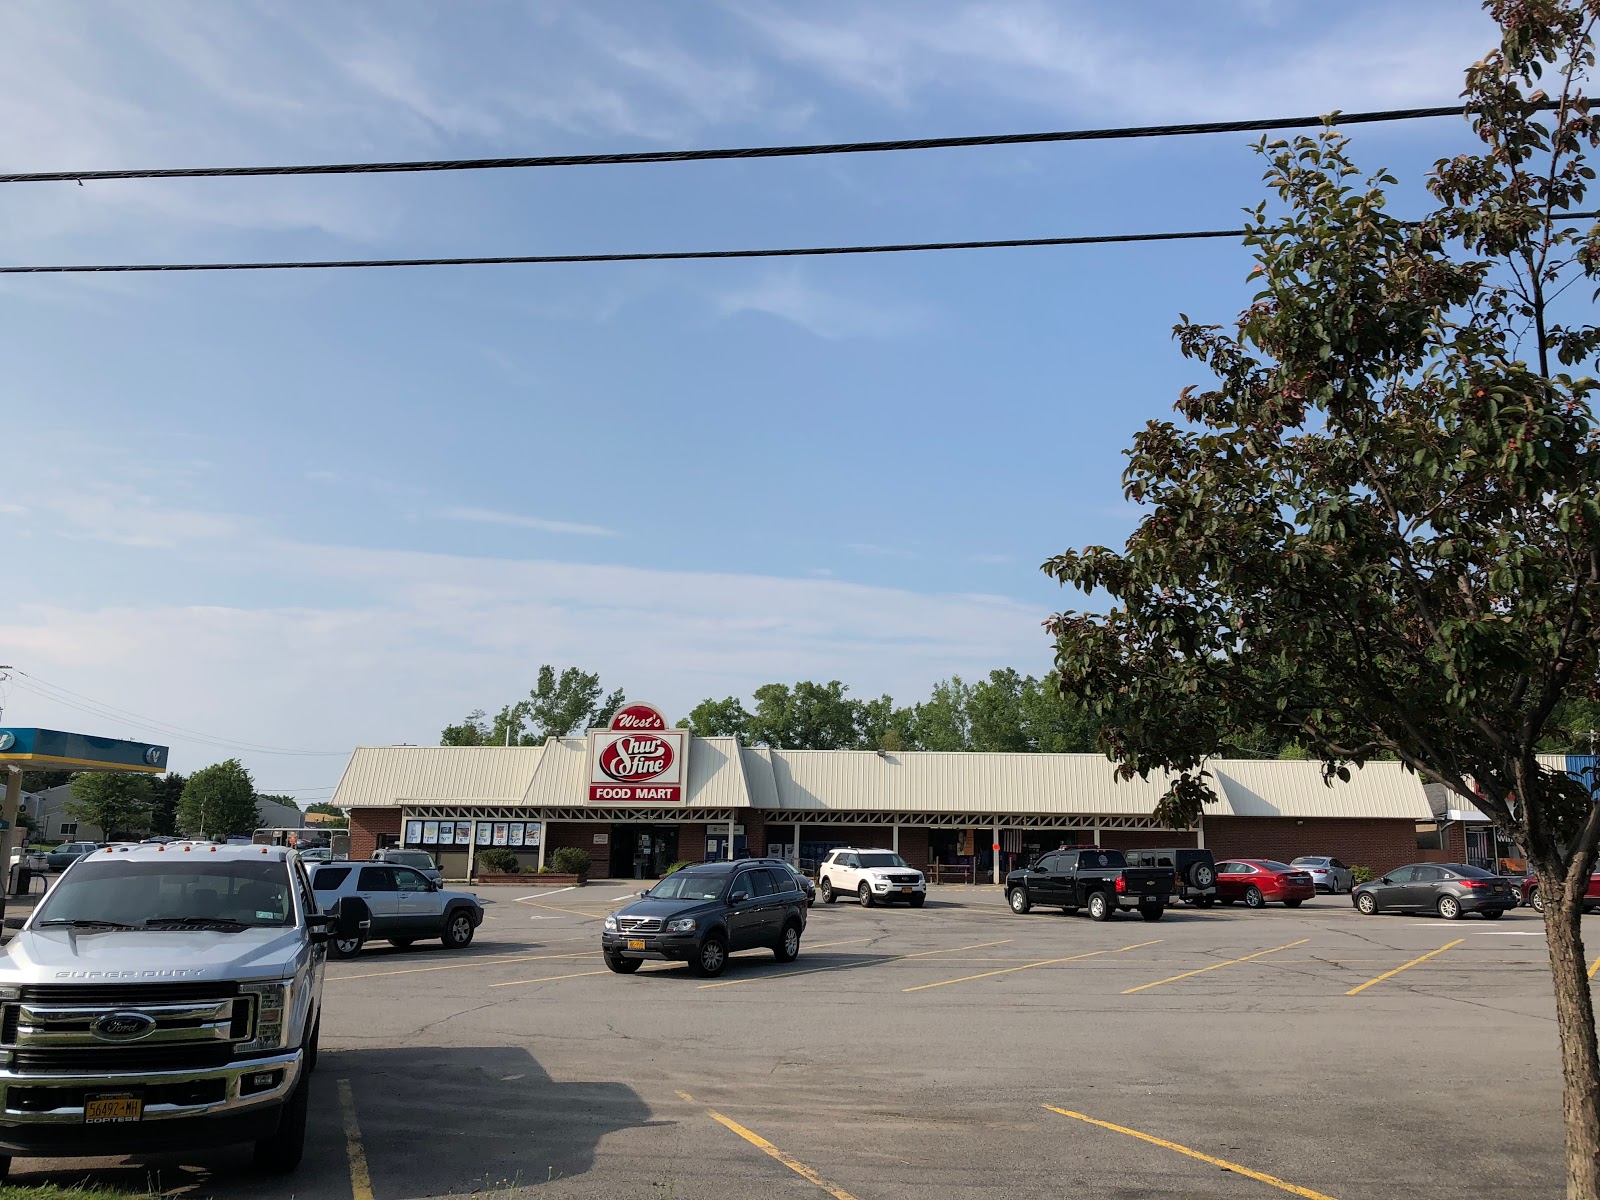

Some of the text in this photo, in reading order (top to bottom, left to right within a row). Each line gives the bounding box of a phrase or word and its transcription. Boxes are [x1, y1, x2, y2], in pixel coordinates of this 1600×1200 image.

[618, 713, 661, 728] West's
[609, 737, 665, 776] Shur
[596, 788, 673, 799] FOOD MART
[55, 969, 206, 979] SUPER DUTY
[106, 1020, 138, 1033] Ford
